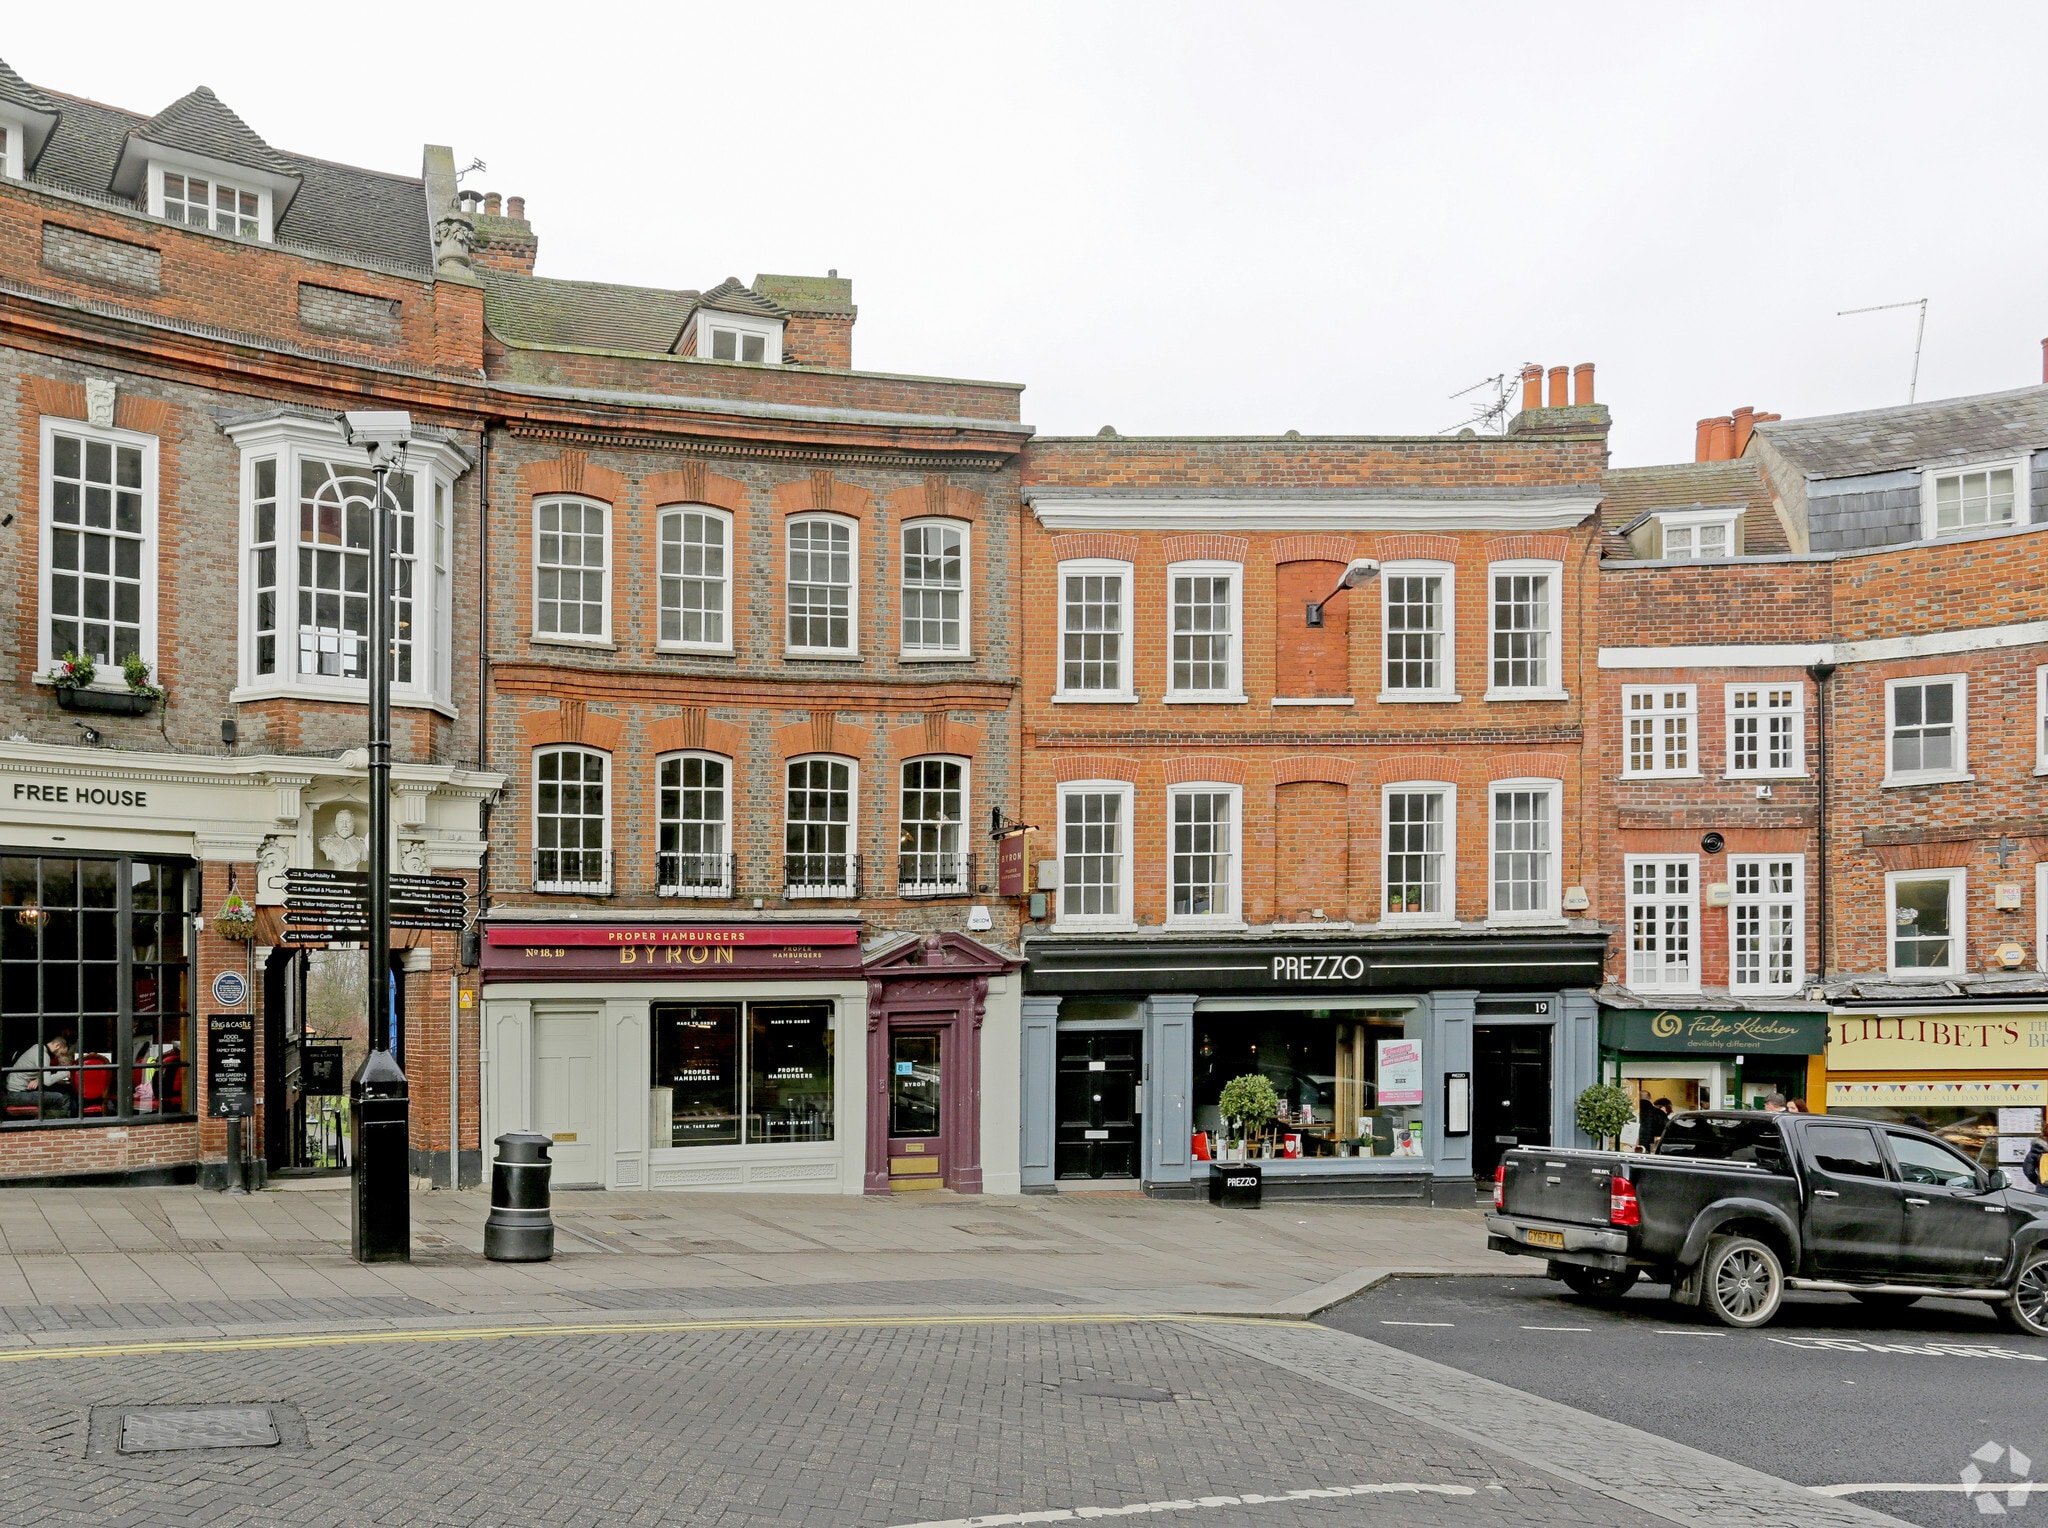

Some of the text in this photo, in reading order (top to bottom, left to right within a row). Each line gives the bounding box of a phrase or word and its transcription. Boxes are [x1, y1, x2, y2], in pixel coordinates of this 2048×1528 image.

[13, 783, 147, 807] FREE HOUSE
[1001, 851, 1022, 863] BYRON
[302, 871, 330, 880] ShopMobility
[608, 932, 745, 941] PROPER HAMBURGERS
[553, 948, 565, 957] 19
[619, 944, 734, 964] BYRON
[1273, 955, 1364, 980] PREZZO
[1535, 1002, 1547, 1014] 19
[1688, 1015, 1800, 1042] Fudge Kitchen
[1840, 1017, 2019, 1048] LILLIBET'S
[1687, 1039, 1761, 1049] devilishly different
[1834, 1095, 1858, 1103] FINE
[1859, 1095, 1882, 1103] TEAS
[1961, 1094, 1980, 1102] DAY
[1983, 1094, 2041, 1102] BREAKFAST
[1227, 1177, 1257, 1187] PREZZO
[1766, 1337, 2047, 1362] LOADING
